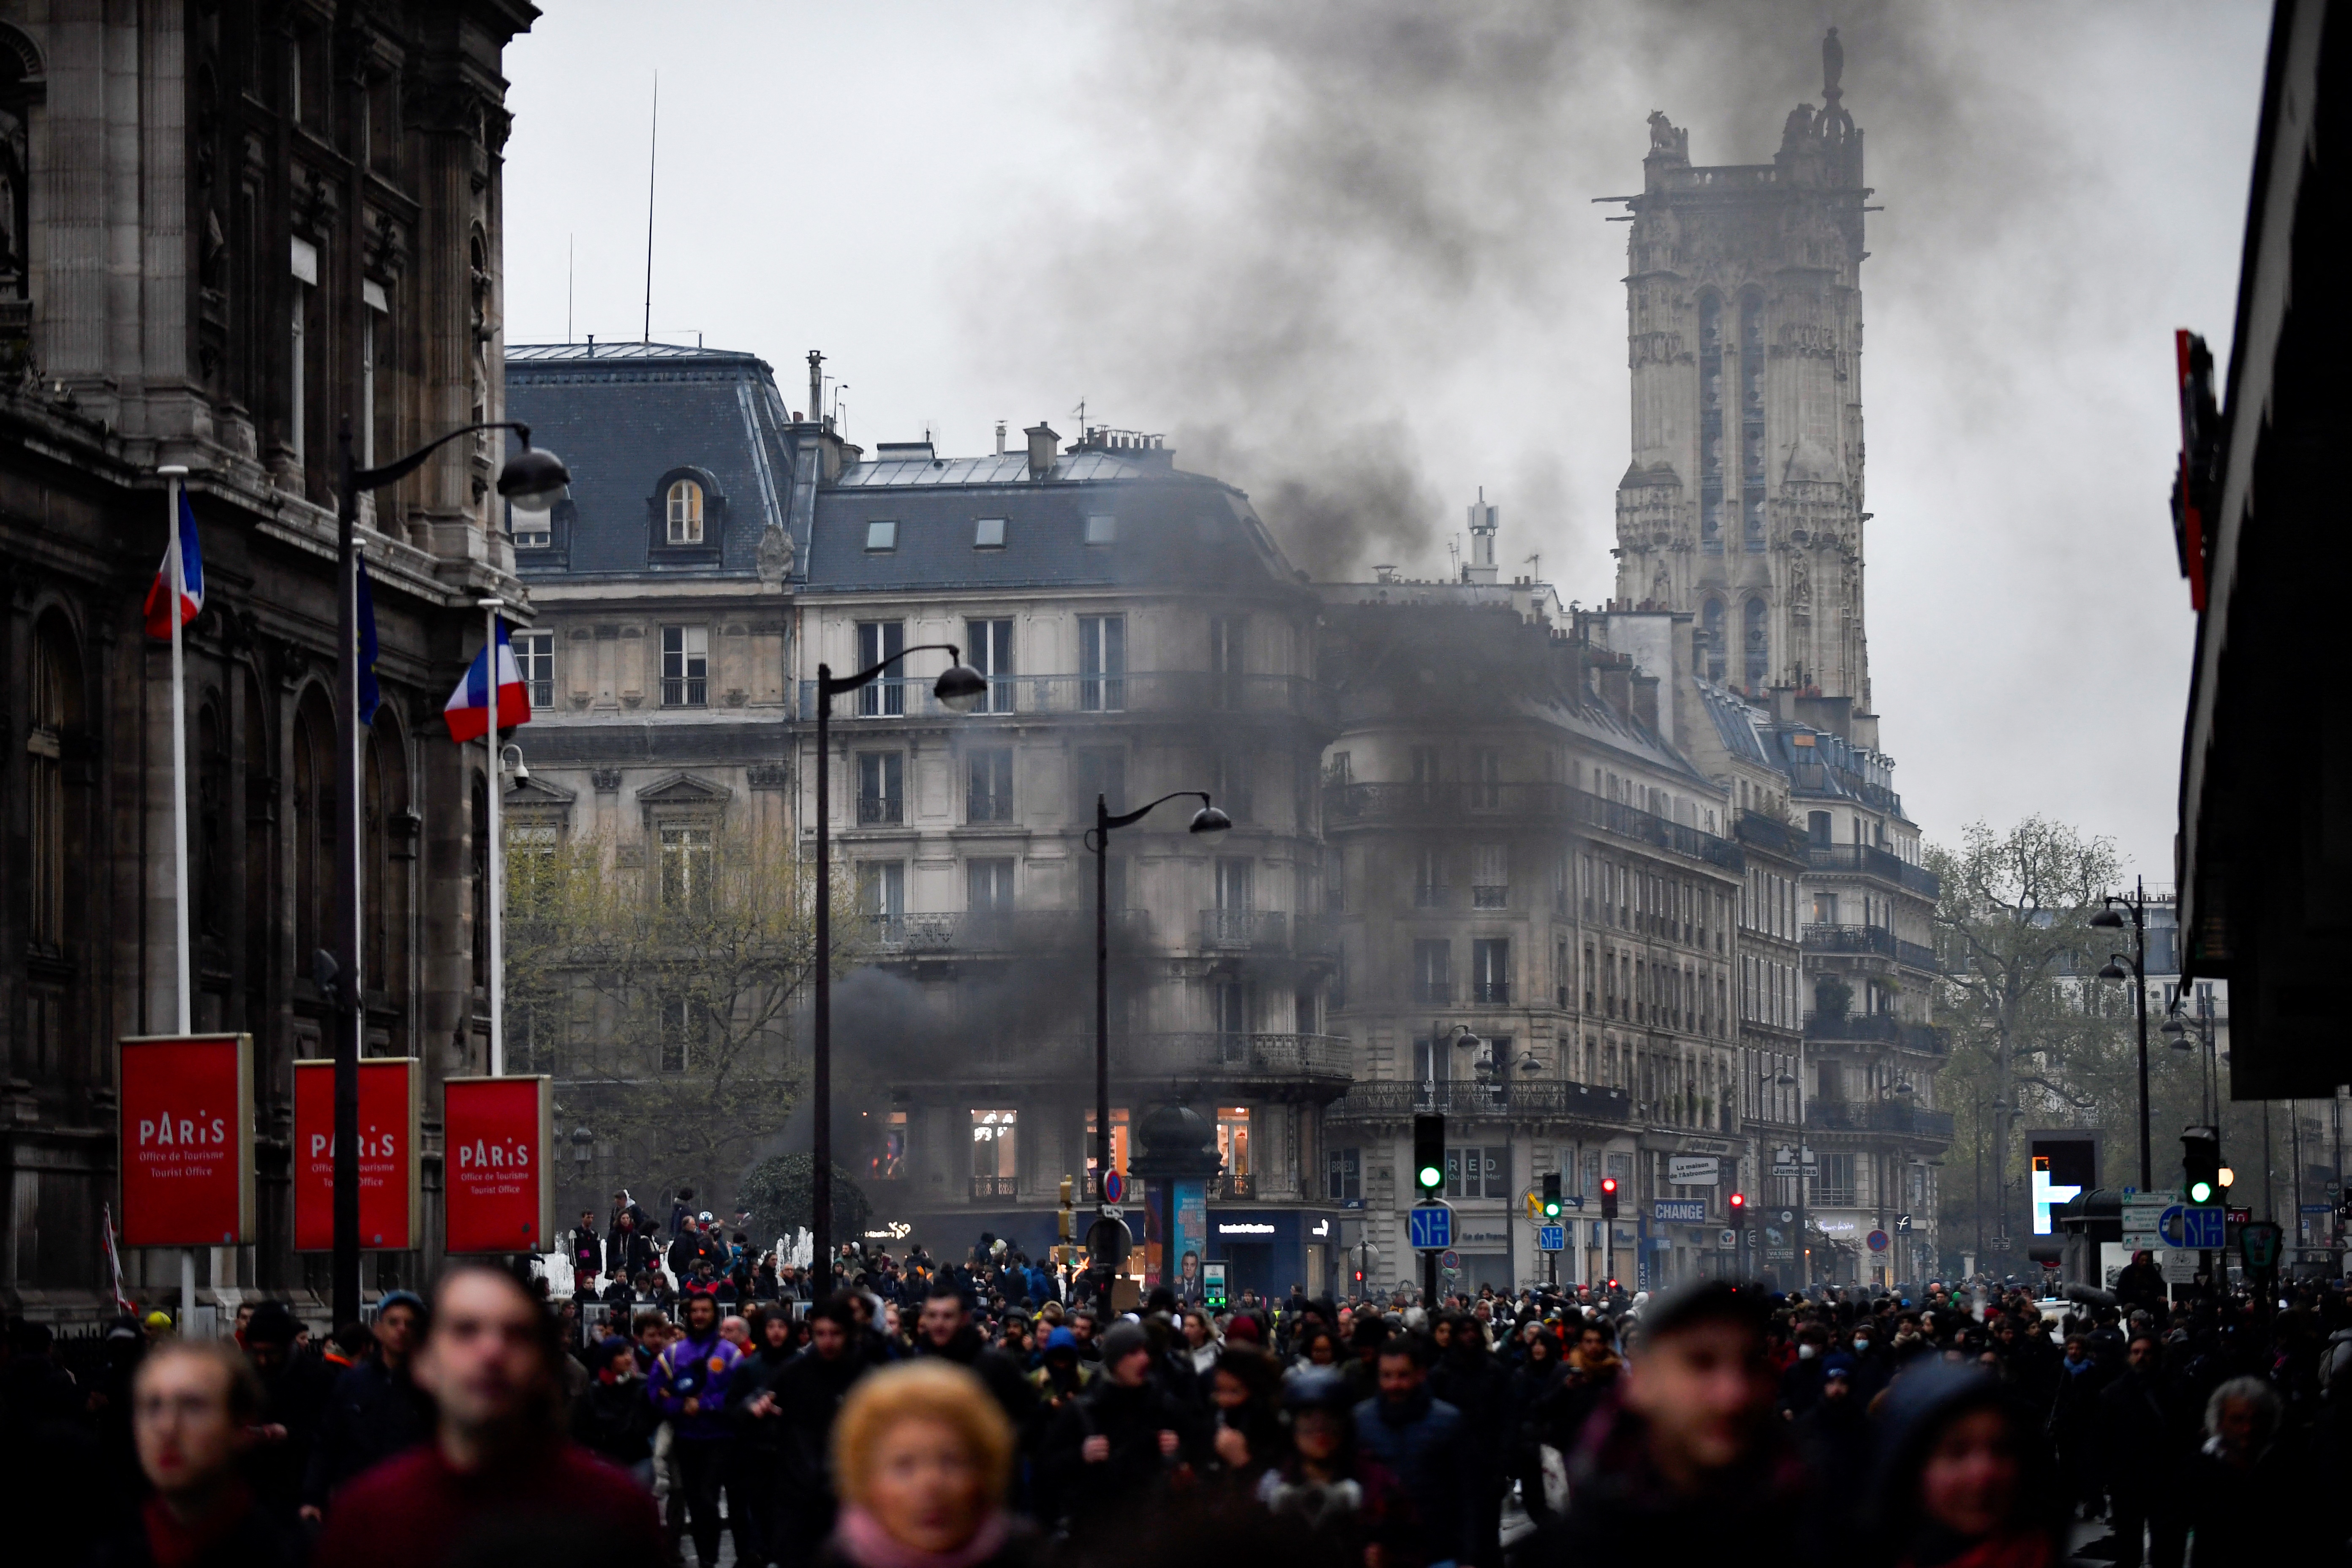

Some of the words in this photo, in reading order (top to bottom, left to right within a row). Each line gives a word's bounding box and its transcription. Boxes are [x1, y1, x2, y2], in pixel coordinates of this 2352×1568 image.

[312, 1125, 394, 1158] PiS
[139, 1151, 166, 1162] Office
[169, 1151, 180, 1162] de
[184, 1150, 224, 1161] Tourisme
[312, 1163, 335, 1173] Offic
[358, 1163, 395, 1172] ourisme
[1448, 1159, 1496, 1171] RED
[151, 1167, 181, 1178] Tourist
[186, 1166, 212, 1176] Office
[461, 1173, 483, 1181] Office
[485, 1172, 494, 1181] de
[496, 1171, 529, 1180] Tourisme
[1679, 1168, 1717, 1178] l'Astronomie
[471, 1186, 495, 1195] Tourist
[498, 1185, 520, 1193] Office
[1655, 1204, 1703, 1219] CHANGE
